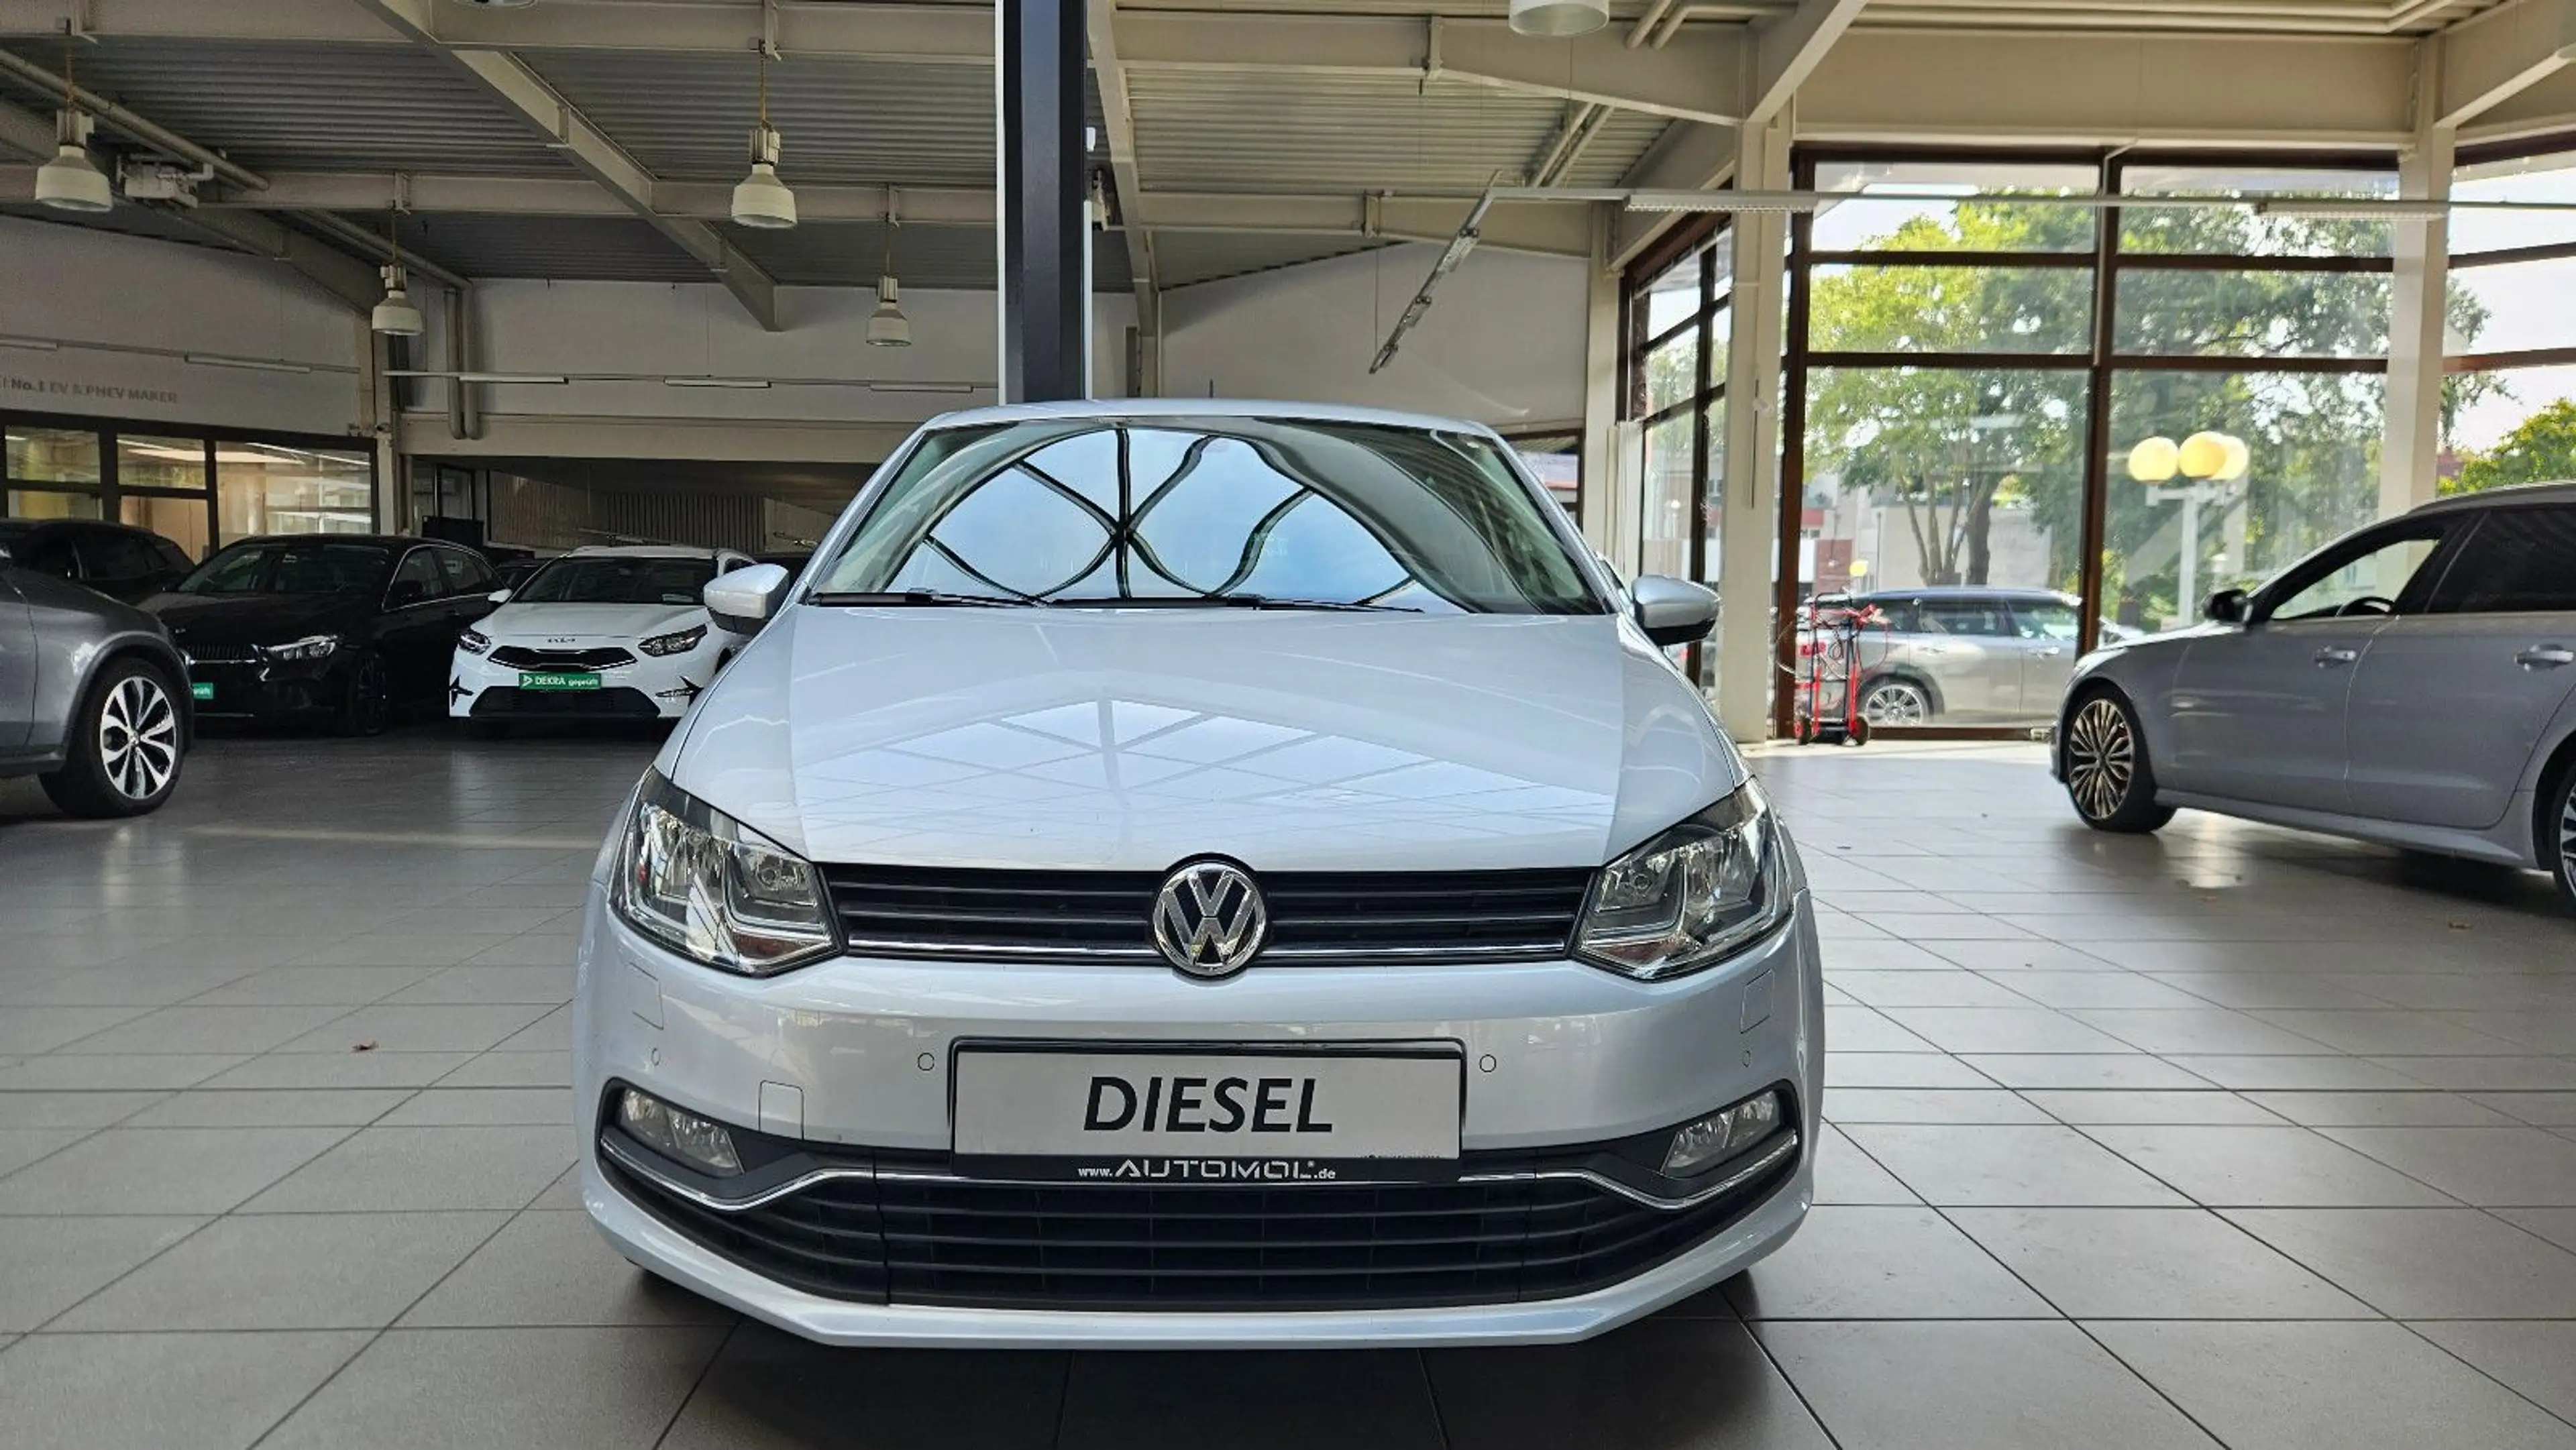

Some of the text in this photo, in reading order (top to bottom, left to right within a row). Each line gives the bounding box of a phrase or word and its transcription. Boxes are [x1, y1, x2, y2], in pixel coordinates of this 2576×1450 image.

[128, 388, 179, 404] MAKER
[535, 675, 566, 685] DEKRA
[1083, 1075, 1333, 1133] DIESEL
